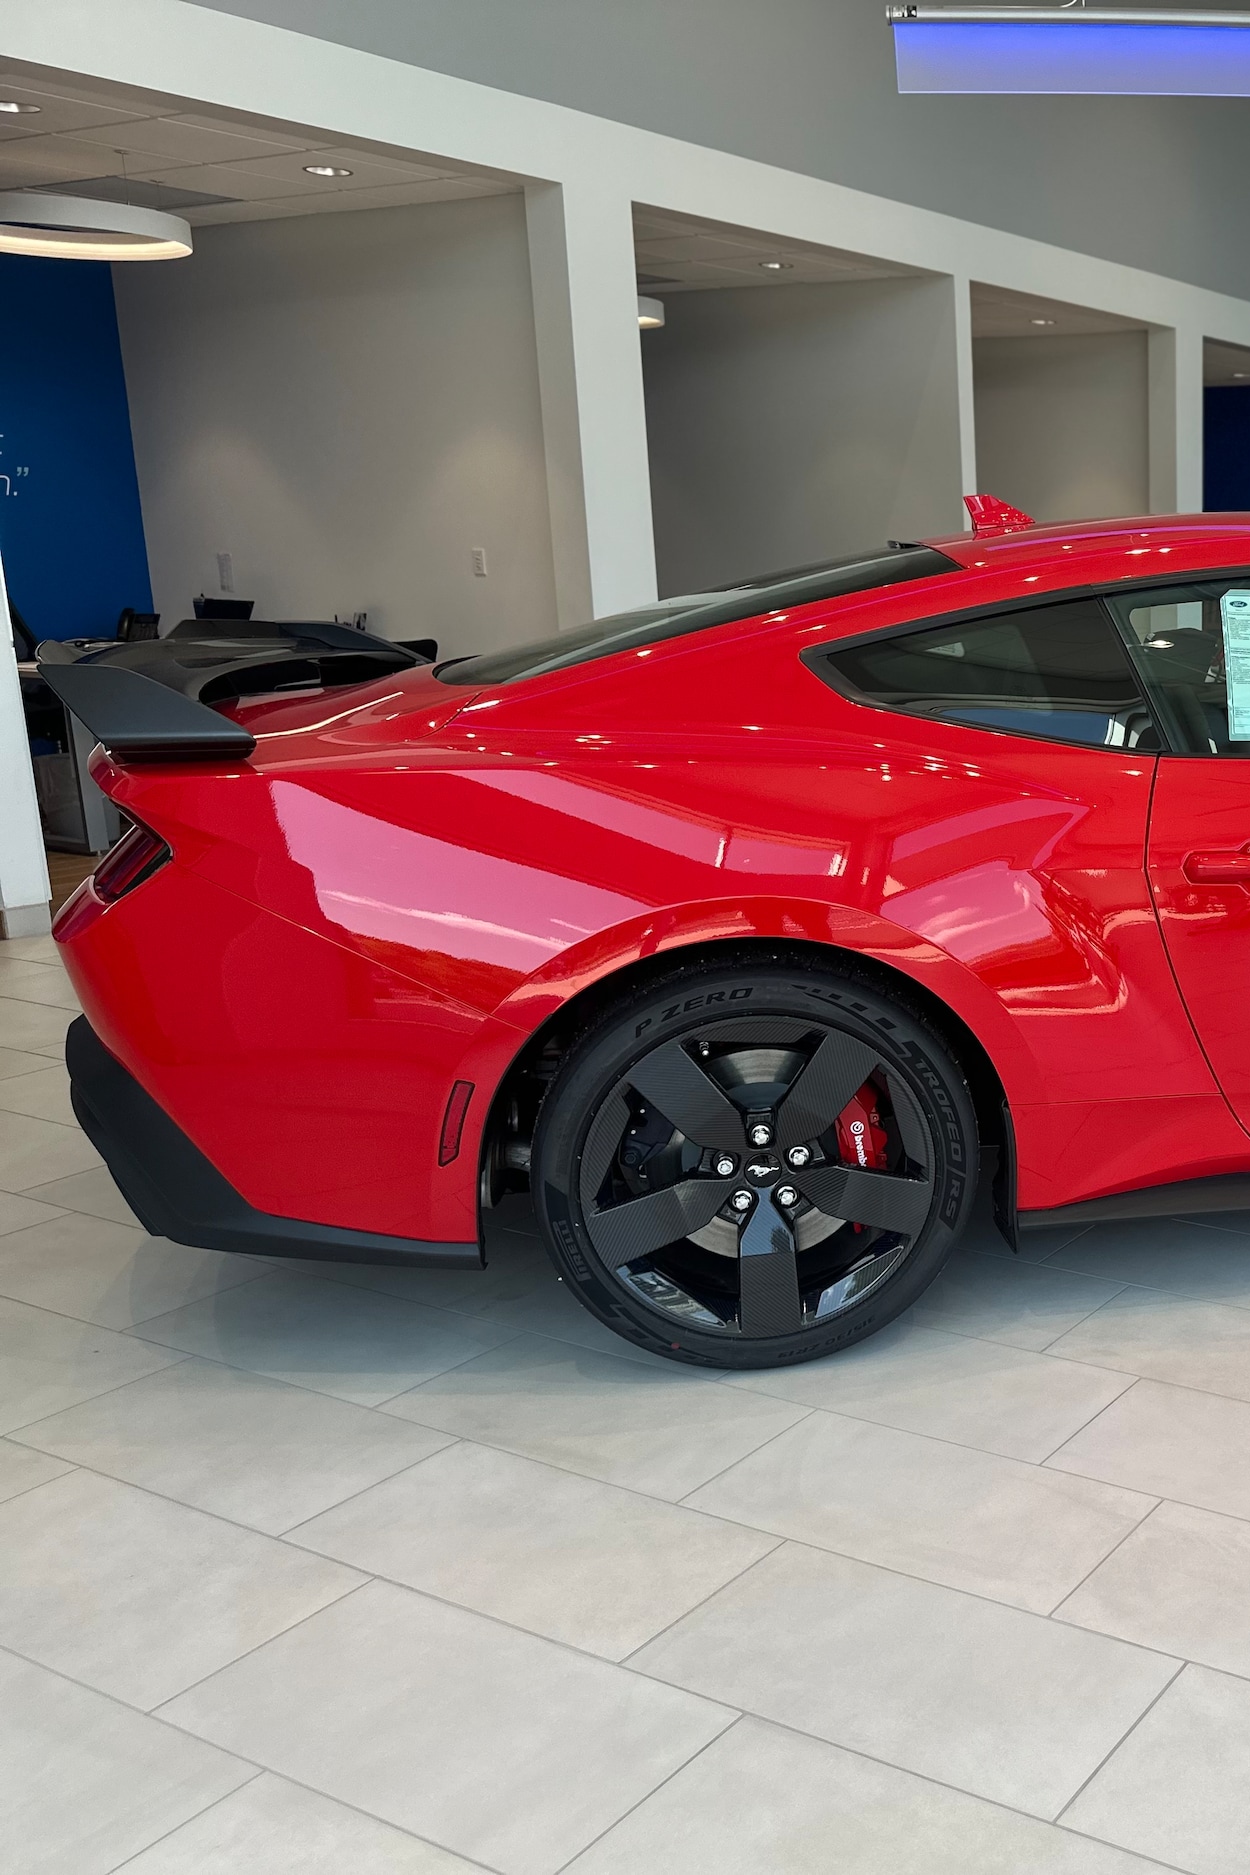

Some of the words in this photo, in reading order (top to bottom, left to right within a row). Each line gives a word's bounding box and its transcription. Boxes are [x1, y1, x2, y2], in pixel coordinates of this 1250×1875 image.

[635, 1018, 652, 1039] P
[660, 987, 754, 1022] ZERO
[914, 1058, 963, 1162] TROFEO
[945, 1179, 963, 1221] RS
[552, 1219, 592, 1282] PIRELLI
